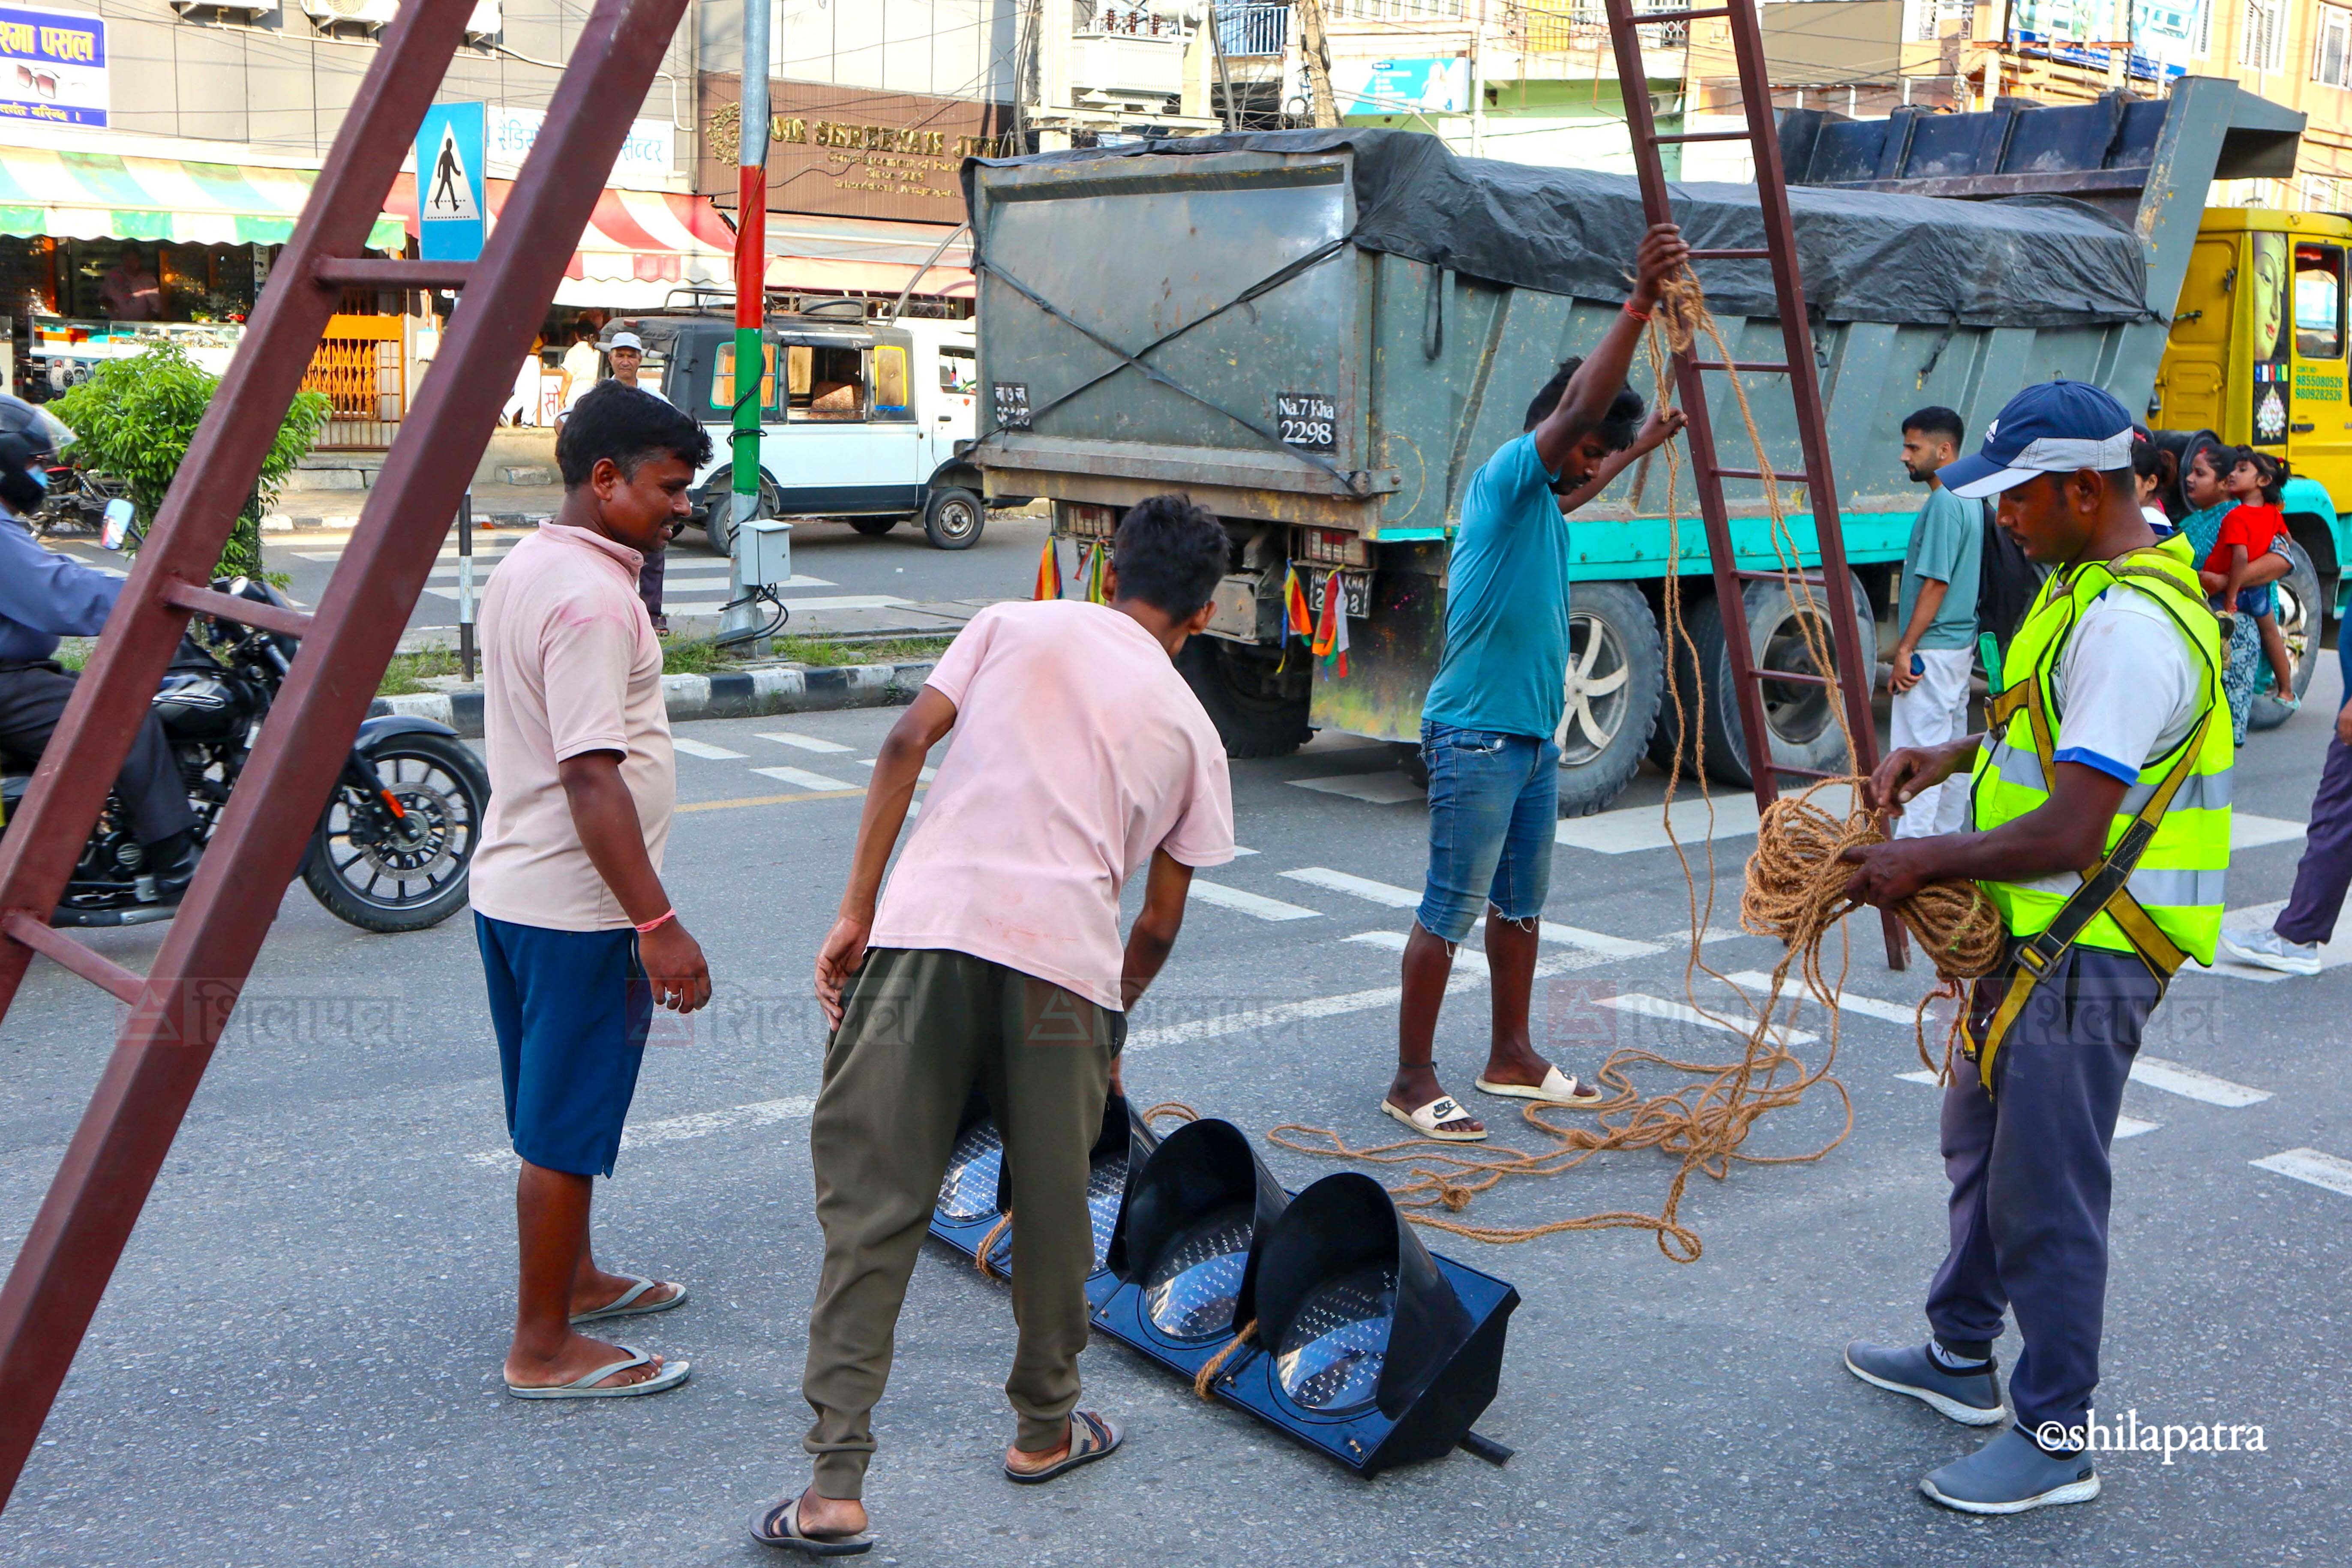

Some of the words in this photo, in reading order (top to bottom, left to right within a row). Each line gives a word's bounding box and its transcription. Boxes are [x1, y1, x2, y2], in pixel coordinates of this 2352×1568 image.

[39, 26, 95, 61] पसल
[918, 159, 930, 170] of
[933, 160, 963, 172] Purit
[2296, 375, 2343, 388] 9855080526
[2295, 388, 2343, 401] 9809282526
[1310, 399, 1335, 420] Kha
[1281, 419, 1332, 445] 2298
[1344, 575, 1365, 591] KHA
